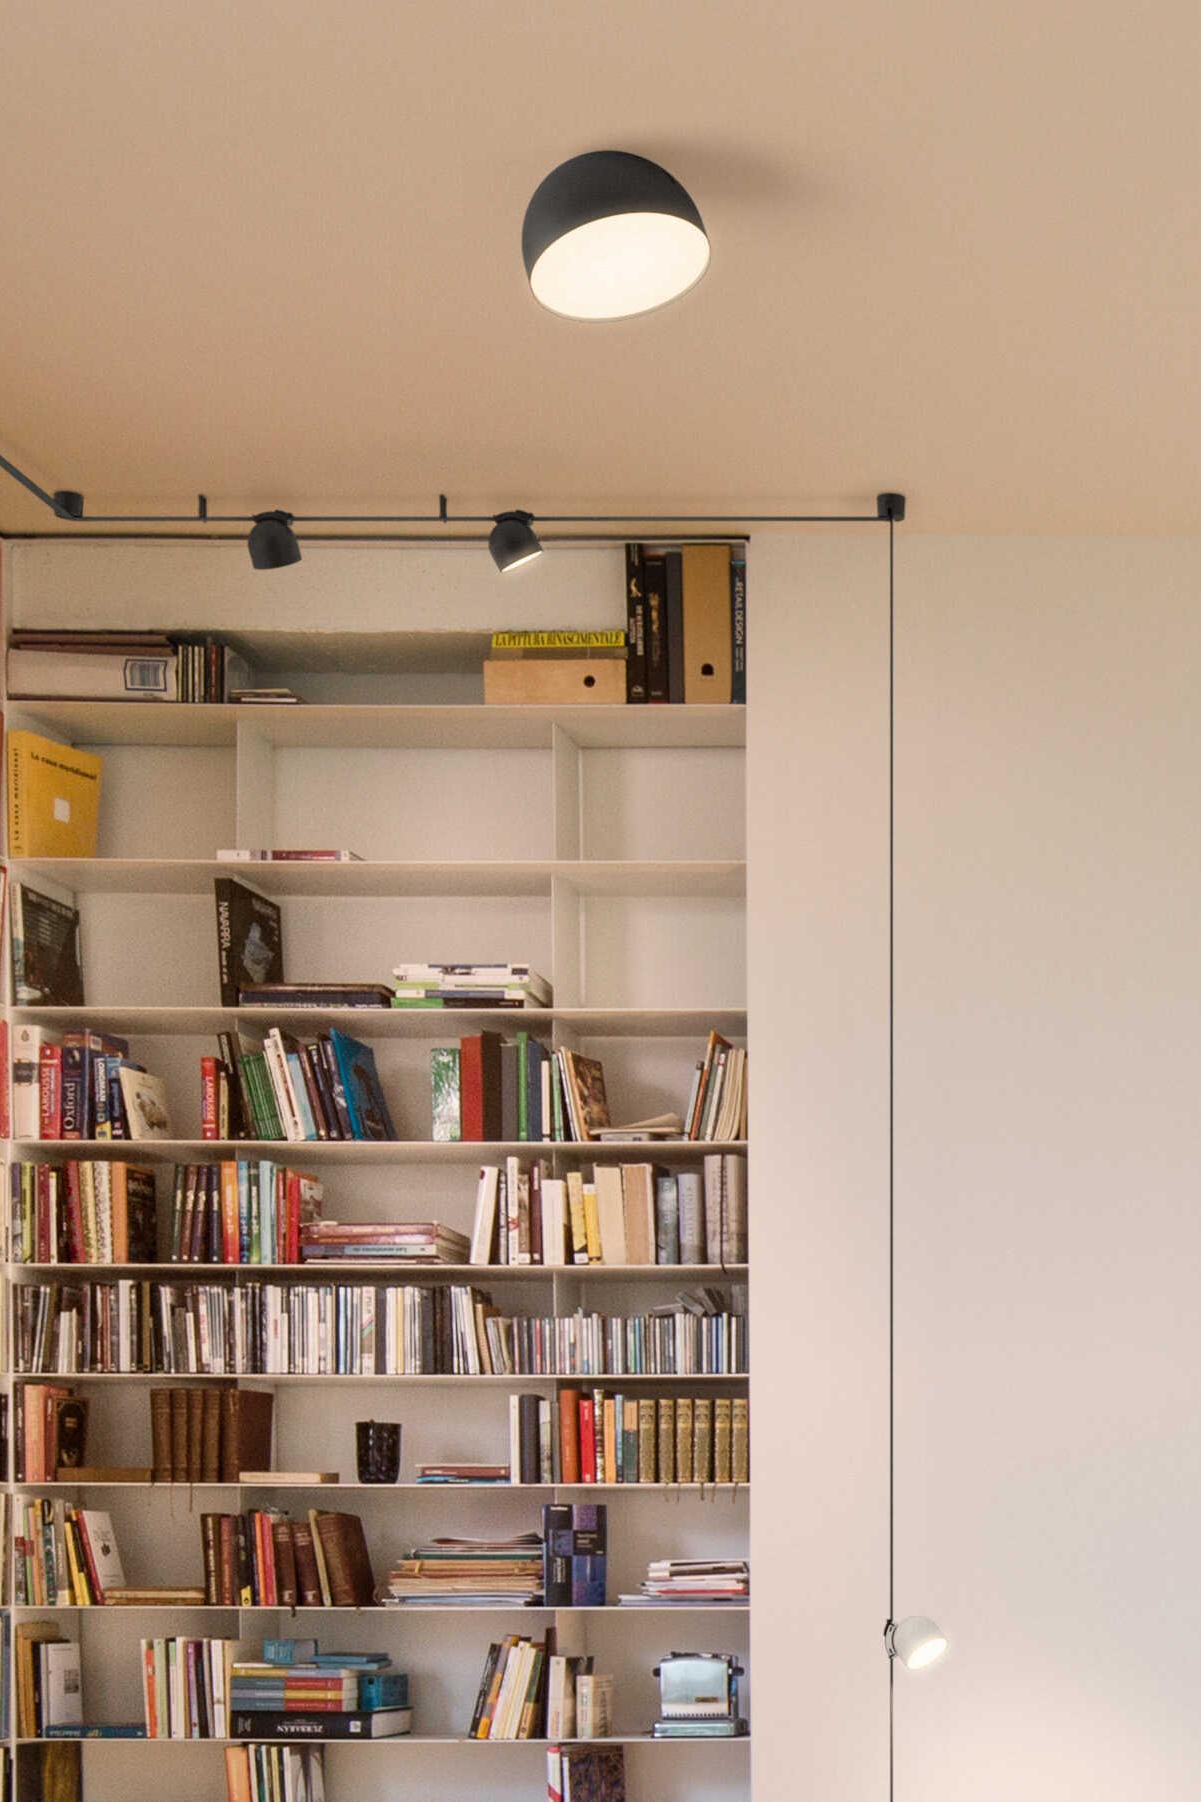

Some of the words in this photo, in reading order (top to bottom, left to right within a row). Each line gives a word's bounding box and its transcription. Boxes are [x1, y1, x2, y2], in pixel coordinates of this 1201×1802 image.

[736, 611, 744, 645] DESIGN
[41, 1067, 50, 1117] LAROUSSE
[63, 1082, 75, 1130] Oxford
